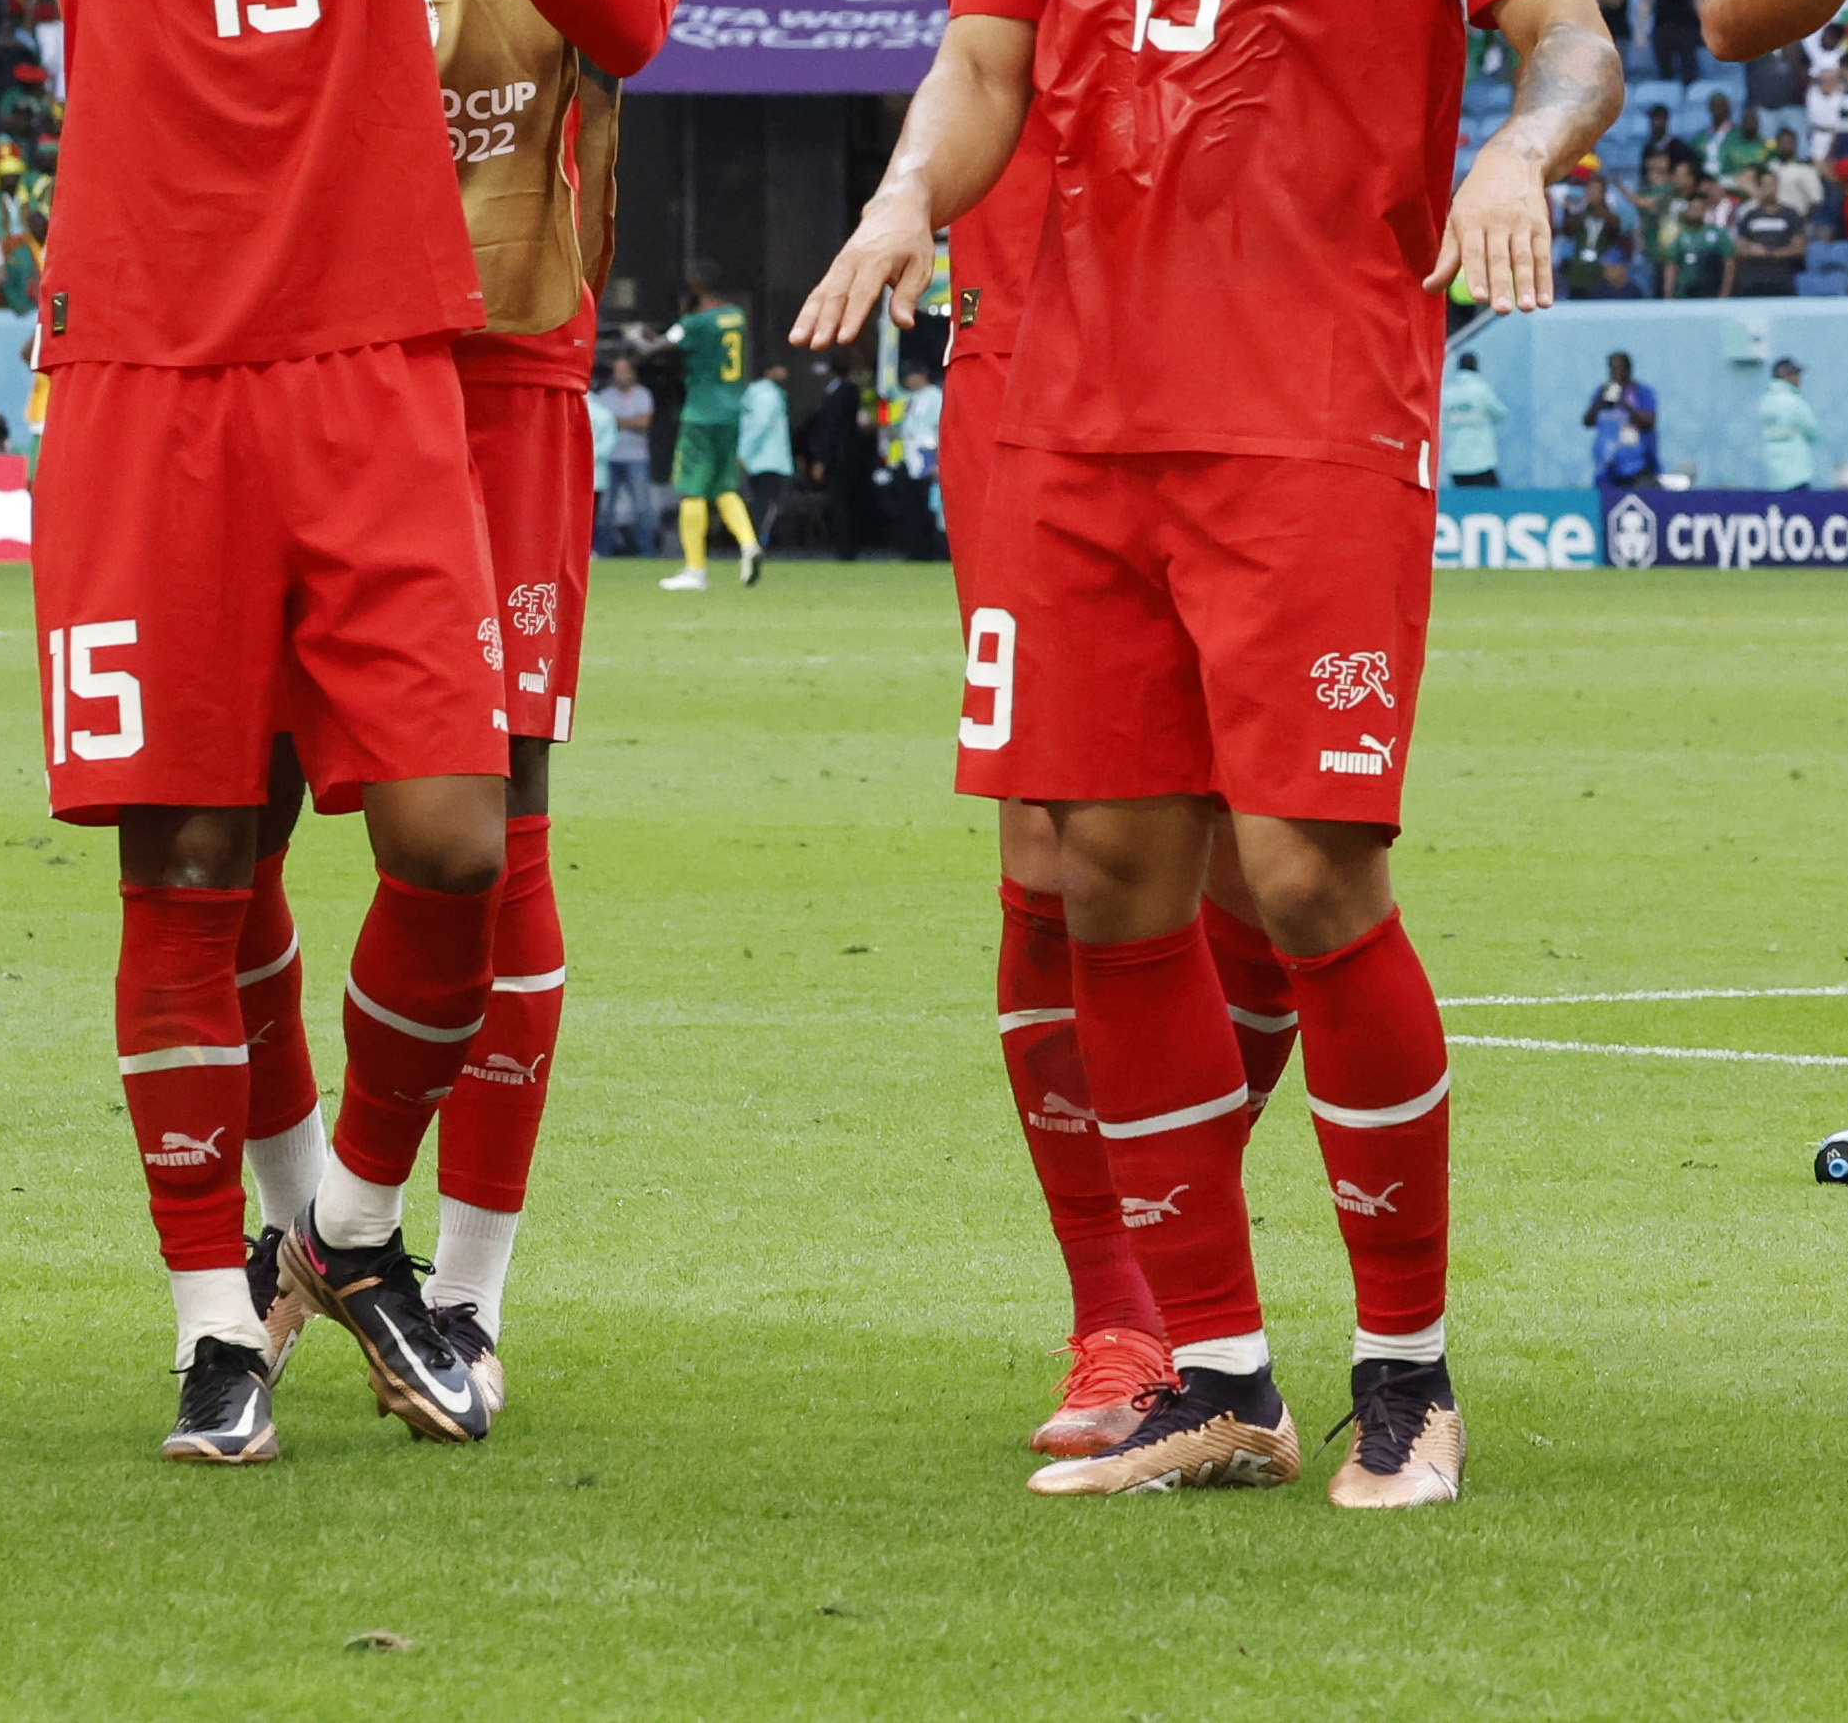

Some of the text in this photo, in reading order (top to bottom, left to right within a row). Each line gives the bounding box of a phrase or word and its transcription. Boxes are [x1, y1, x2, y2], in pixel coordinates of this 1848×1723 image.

[466, 80, 537, 120] CUP
[720, 330, 743, 382] 3
[1433, 513, 1599, 568] ense
[48, 618, 145, 765] 15
[957, 606, 1017, 750] 9
[1319, 751, 1383, 776] PUMA
[461, 1064, 525, 1085] PUMA
[145, 1150, 207, 1167] PUMA
